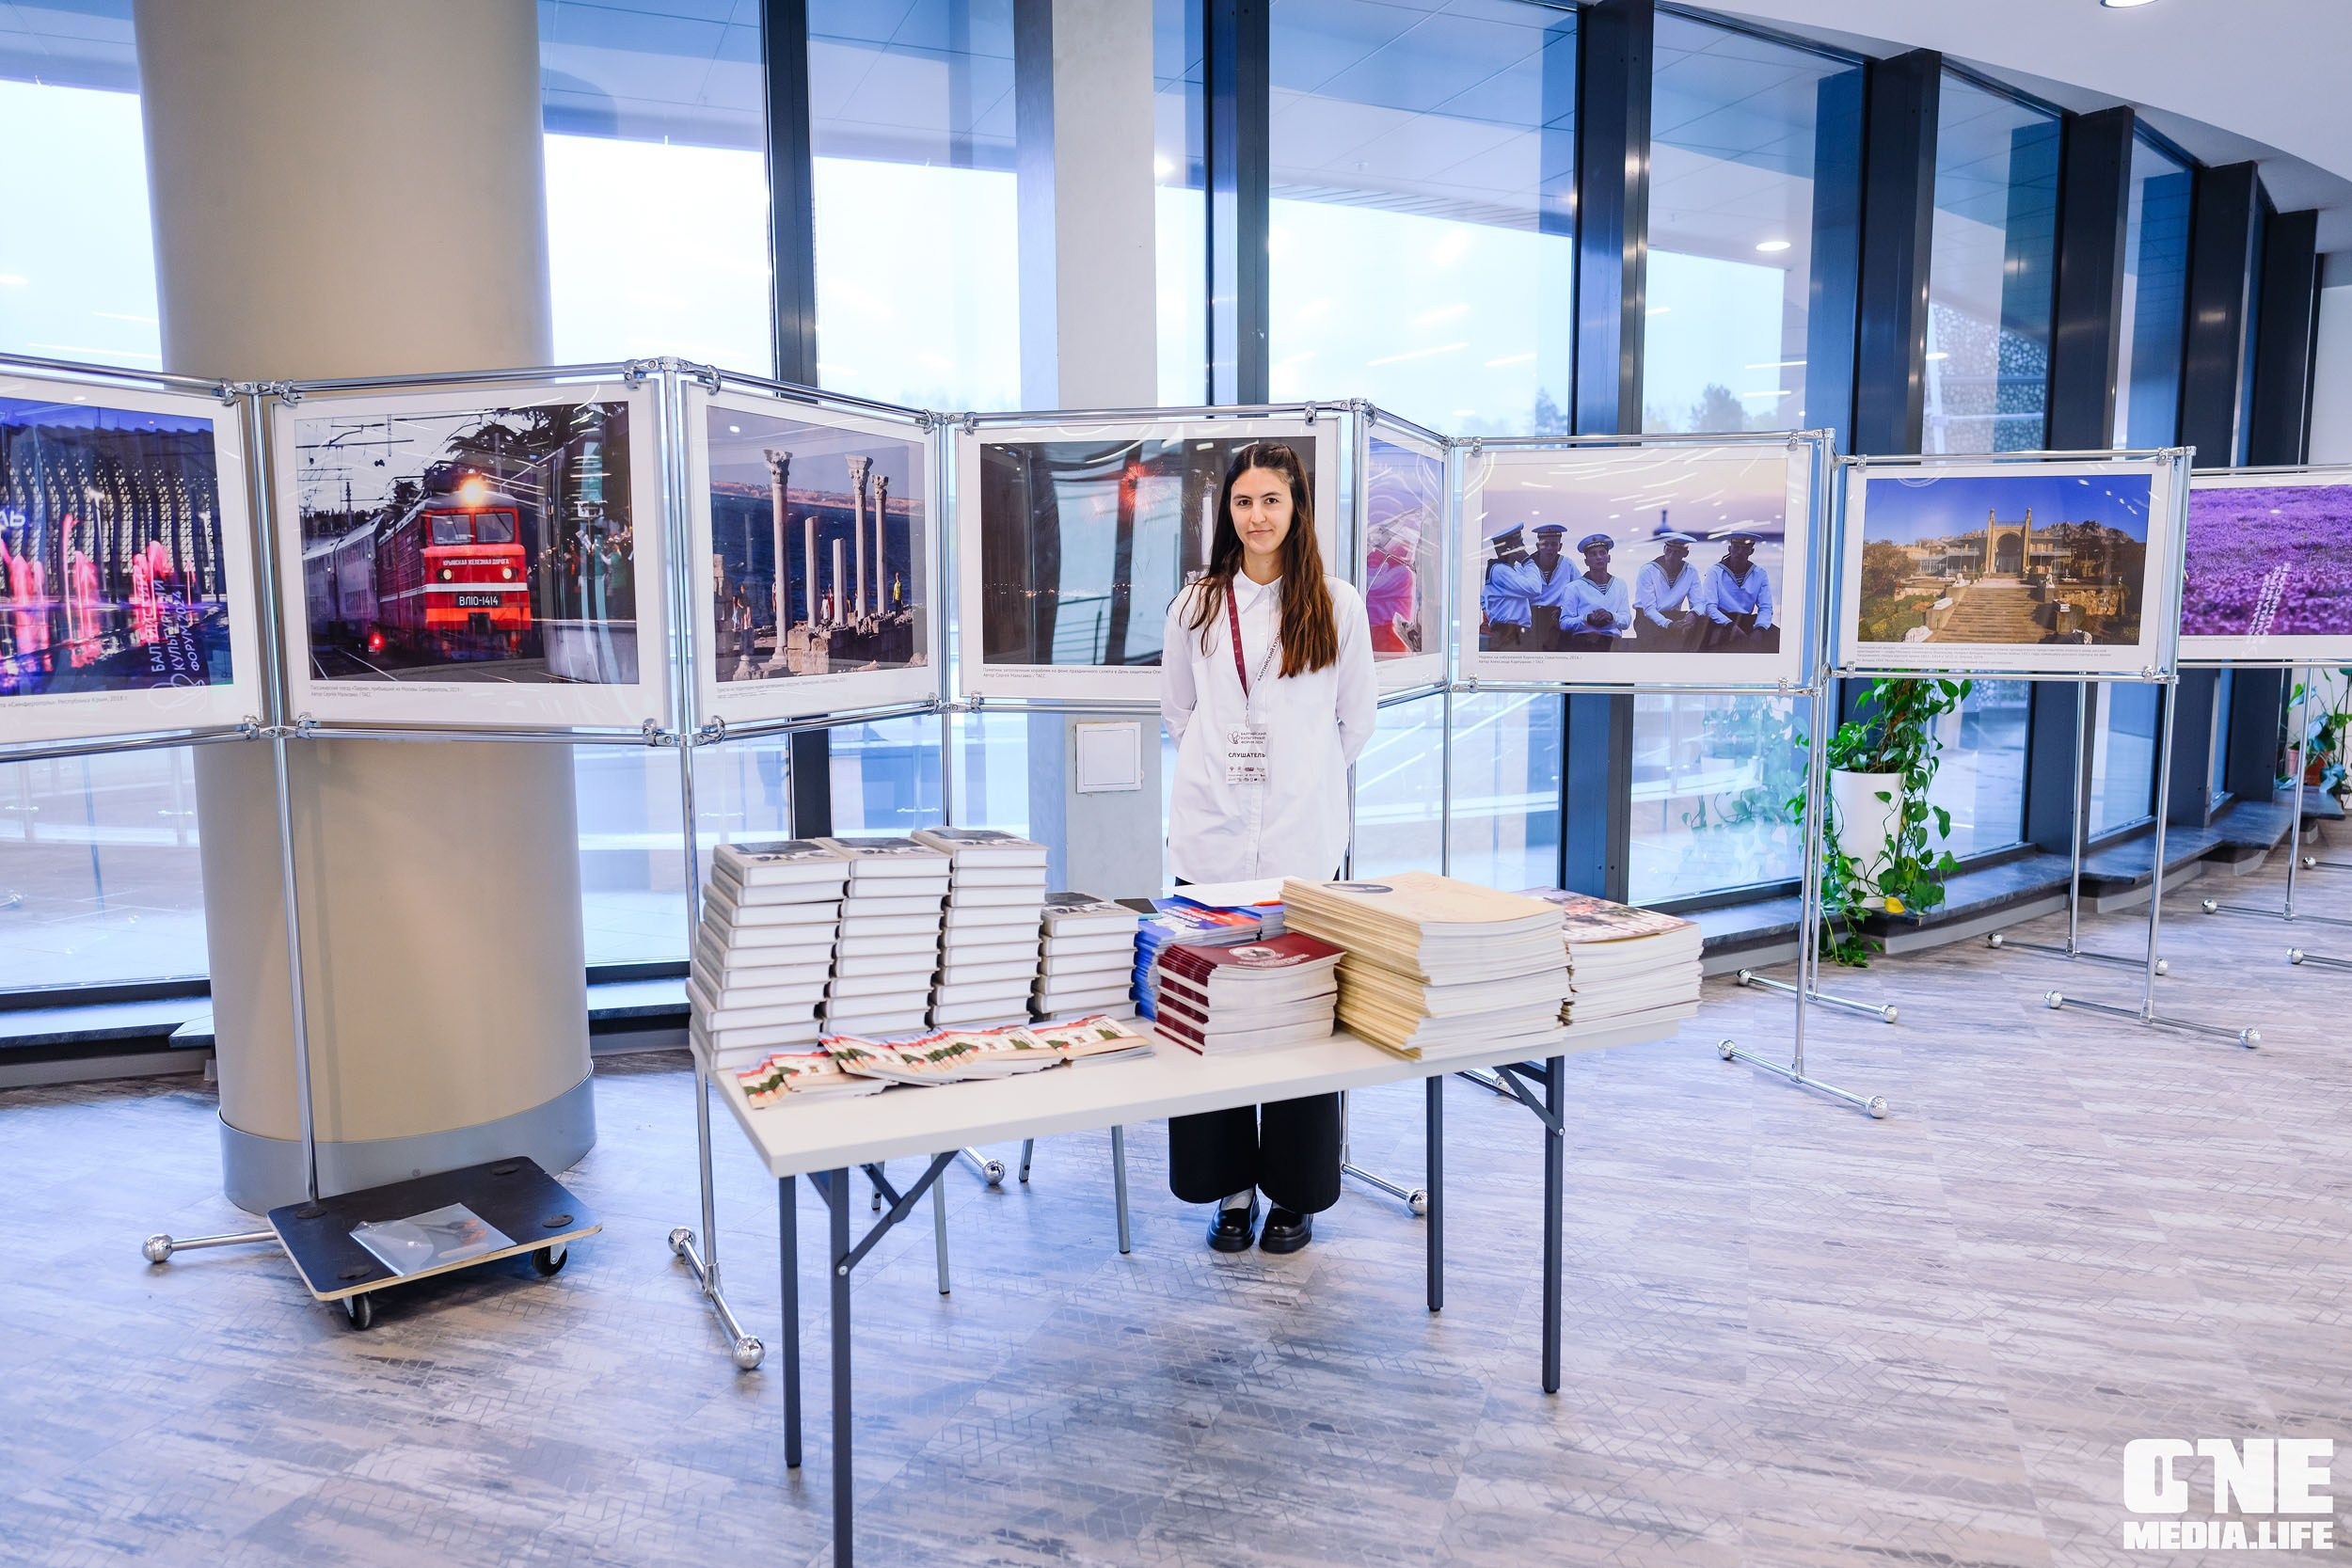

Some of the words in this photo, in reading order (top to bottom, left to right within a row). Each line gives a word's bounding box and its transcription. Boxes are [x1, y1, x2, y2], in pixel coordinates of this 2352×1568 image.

[153, 579, 186, 672] КУЛЬТУРНЫЙ
[172, 590, 189, 623] 2024
[180, 625, 199, 672] ФОРУМ
